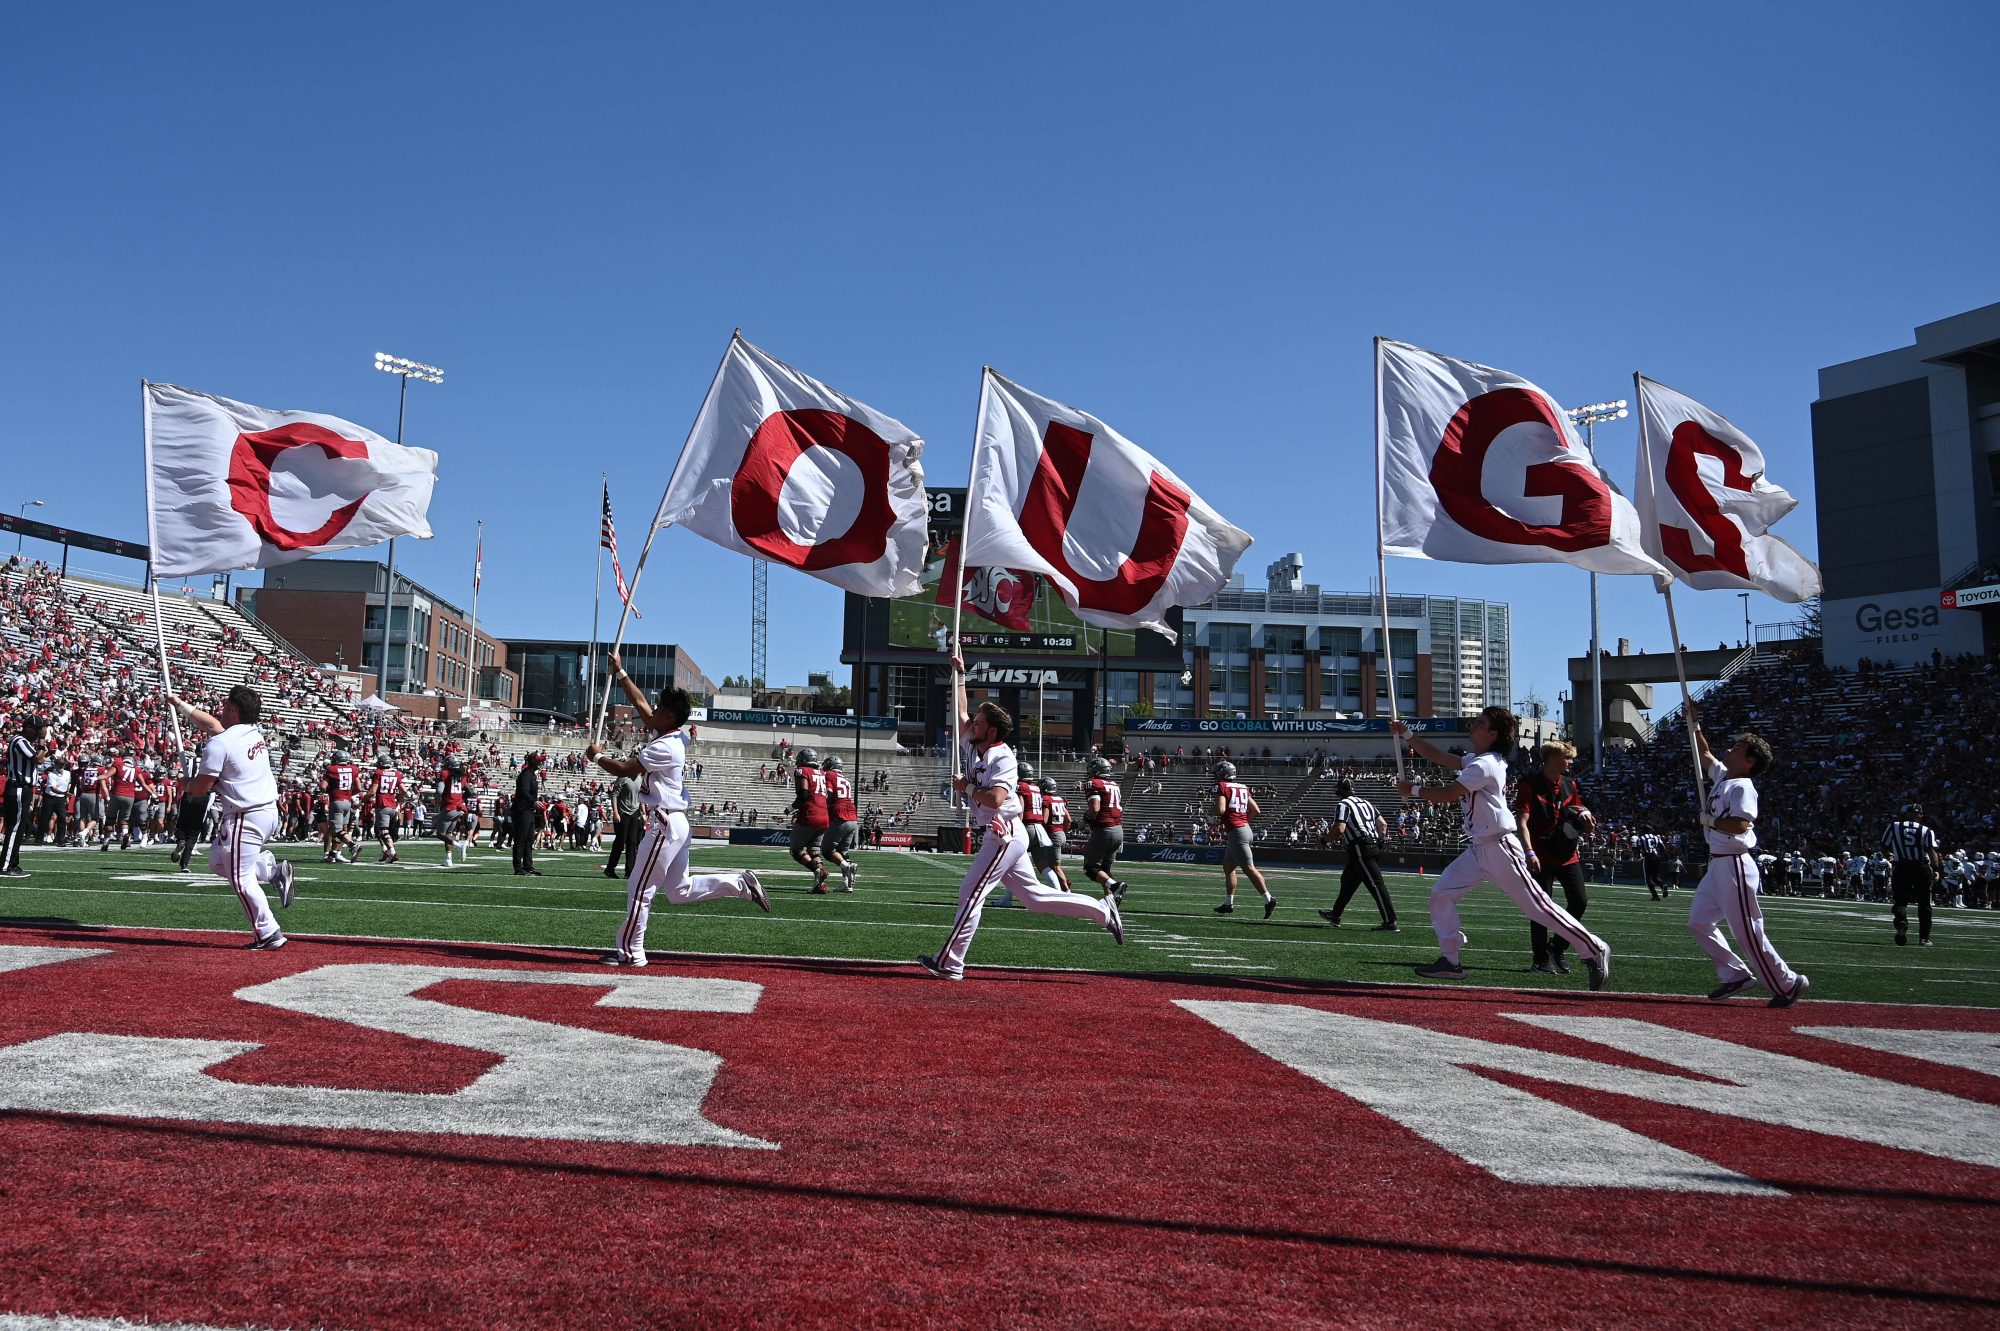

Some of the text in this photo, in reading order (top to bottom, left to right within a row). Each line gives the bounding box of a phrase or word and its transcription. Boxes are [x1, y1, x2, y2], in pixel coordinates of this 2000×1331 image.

[1429, 387, 1612, 552] G
[228, 422, 369, 550] C
[731, 408, 897, 571] O
[1659, 420, 1755, 580] S
[1017, 420, 1191, 615] U
[1960, 590, 2000, 603] TOYOTA
[1856, 603, 1940, 633] Gesa
[1042, 638, 1073, 647] 10:28
[1876, 633, 1919, 644] FIELD
[949, 661, 1059, 685] AVISTA
[712, 711, 848, 727] FROM WSU TO THE WORLD
[1137, 719, 1173, 731] Alaska
[1199, 721, 1219, 731] GO
[1221, 721, 1270, 731] GLOBAL
[1272, 721, 1305, 731] WITH
[1402, 721, 1427, 732] laska
[122, 766, 136, 783] 71
[338, 772, 353, 790] 61
[380, 775, 398, 794] 67
[1228, 788, 1249, 814] 49
[762, 830, 791, 843] Alas
[1903, 828, 1917, 846] S
[1151, 848, 1195, 862] Alaska
